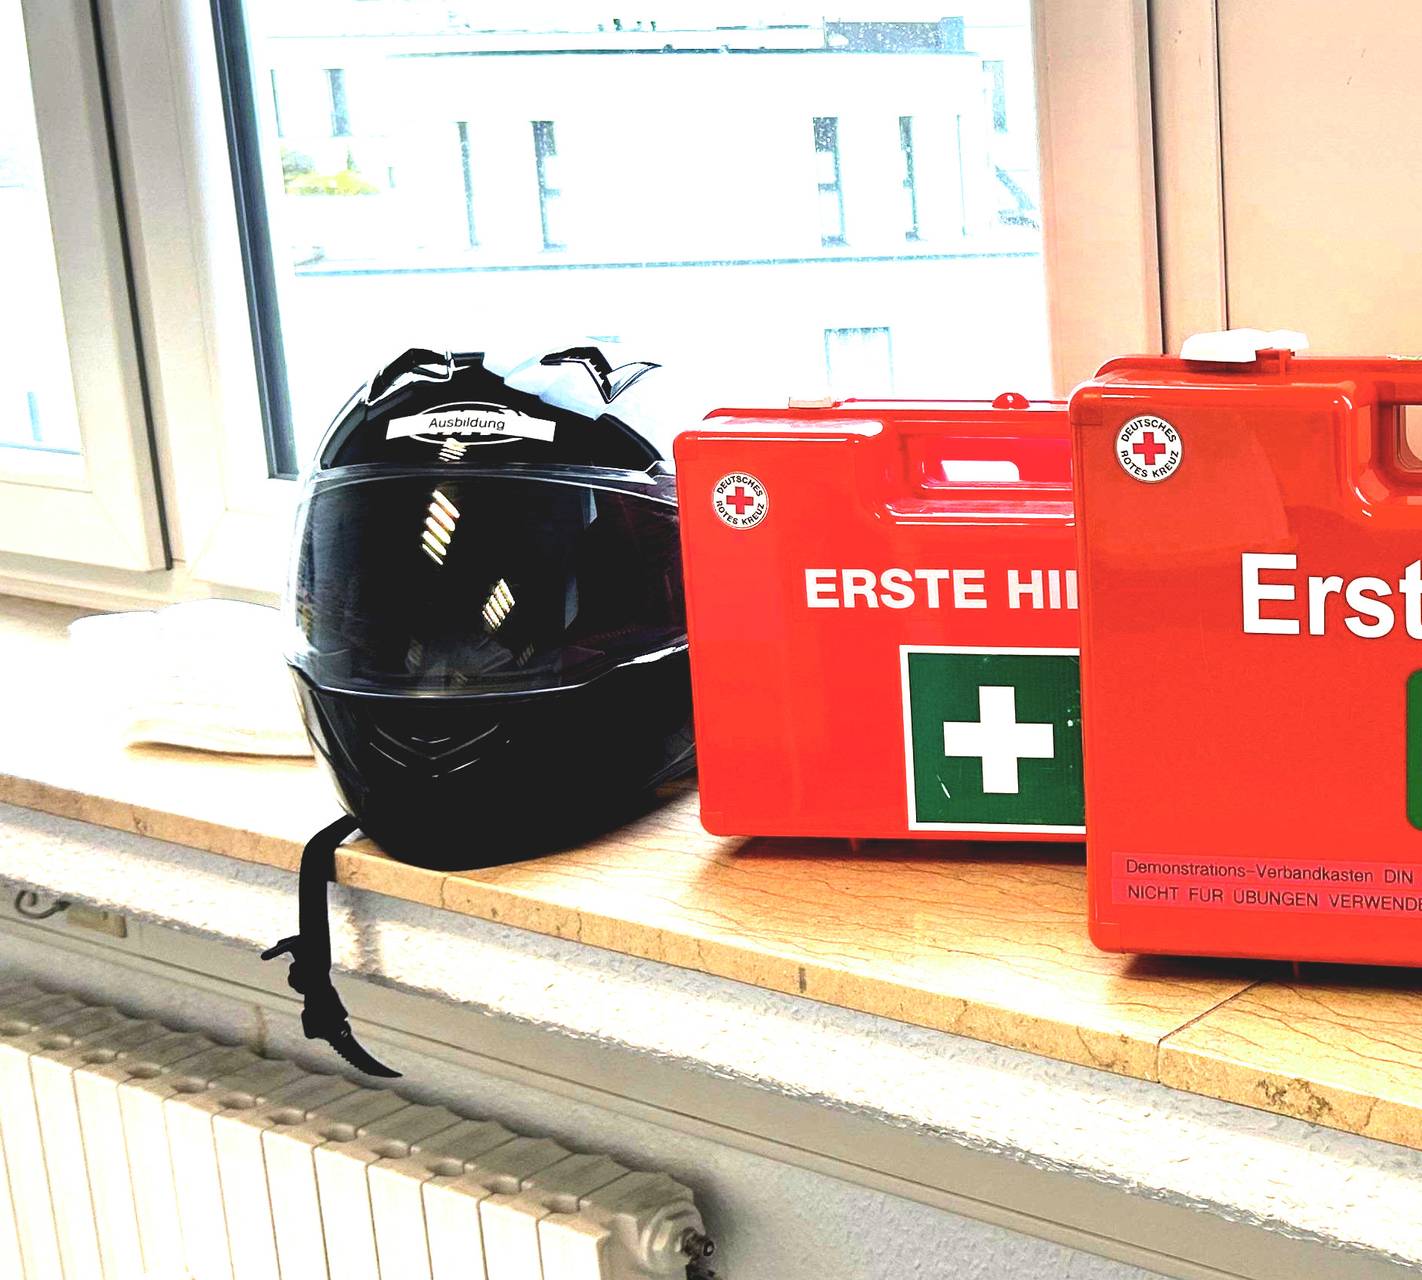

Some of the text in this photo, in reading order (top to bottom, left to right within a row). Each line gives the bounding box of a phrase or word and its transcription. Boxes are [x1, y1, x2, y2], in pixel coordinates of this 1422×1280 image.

[428, 417, 506, 431] Ausbildung
[1120, 418, 1177, 443] DEUTSCHES
[1120, 449, 1180, 478] ROTES KREUZ
[716, 475, 764, 497] DEUTSCHES
[715, 500, 765, 525] ROTES KREUZ
[804, 568, 988, 609] ERSTE
[1126, 859, 1374, 883] Demonstrations-Verbandkasten
[1384, 869, 1413, 885] DIN
[1128, 885, 1179, 901] NICHT
